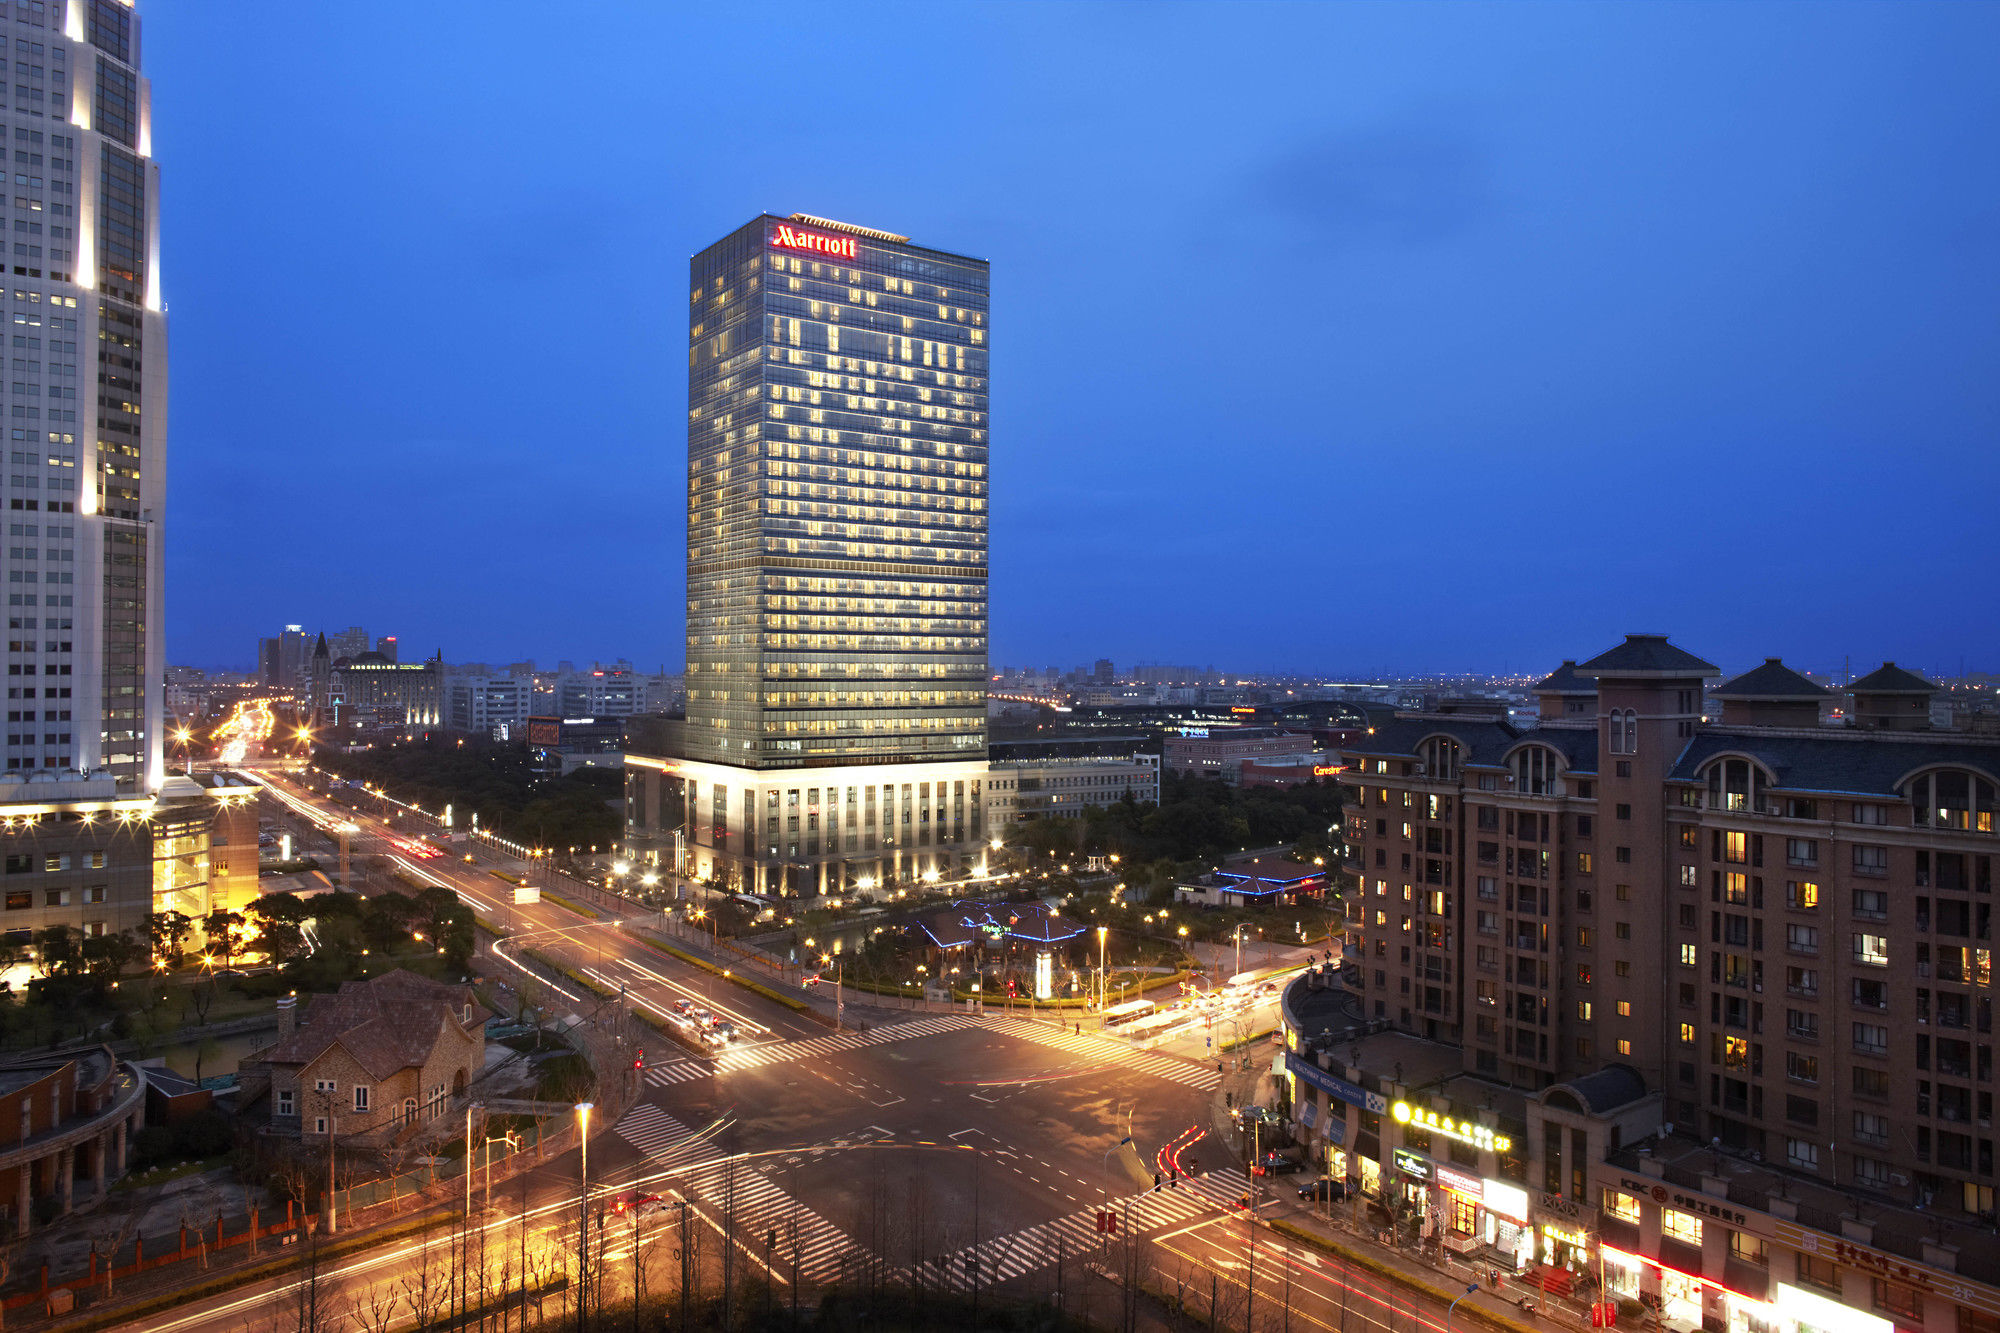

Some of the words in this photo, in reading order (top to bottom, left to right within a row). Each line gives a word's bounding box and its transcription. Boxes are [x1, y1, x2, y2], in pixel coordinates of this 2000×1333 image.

[772, 224, 855, 258] Marriott
[1320, 1077, 1343, 1094] MEDICAL
[1494, 1135, 1511, 1151] 2F
[1620, 1177, 1649, 1195] ICBC
[1673, 1193, 1746, 1226] 中国工商银行
